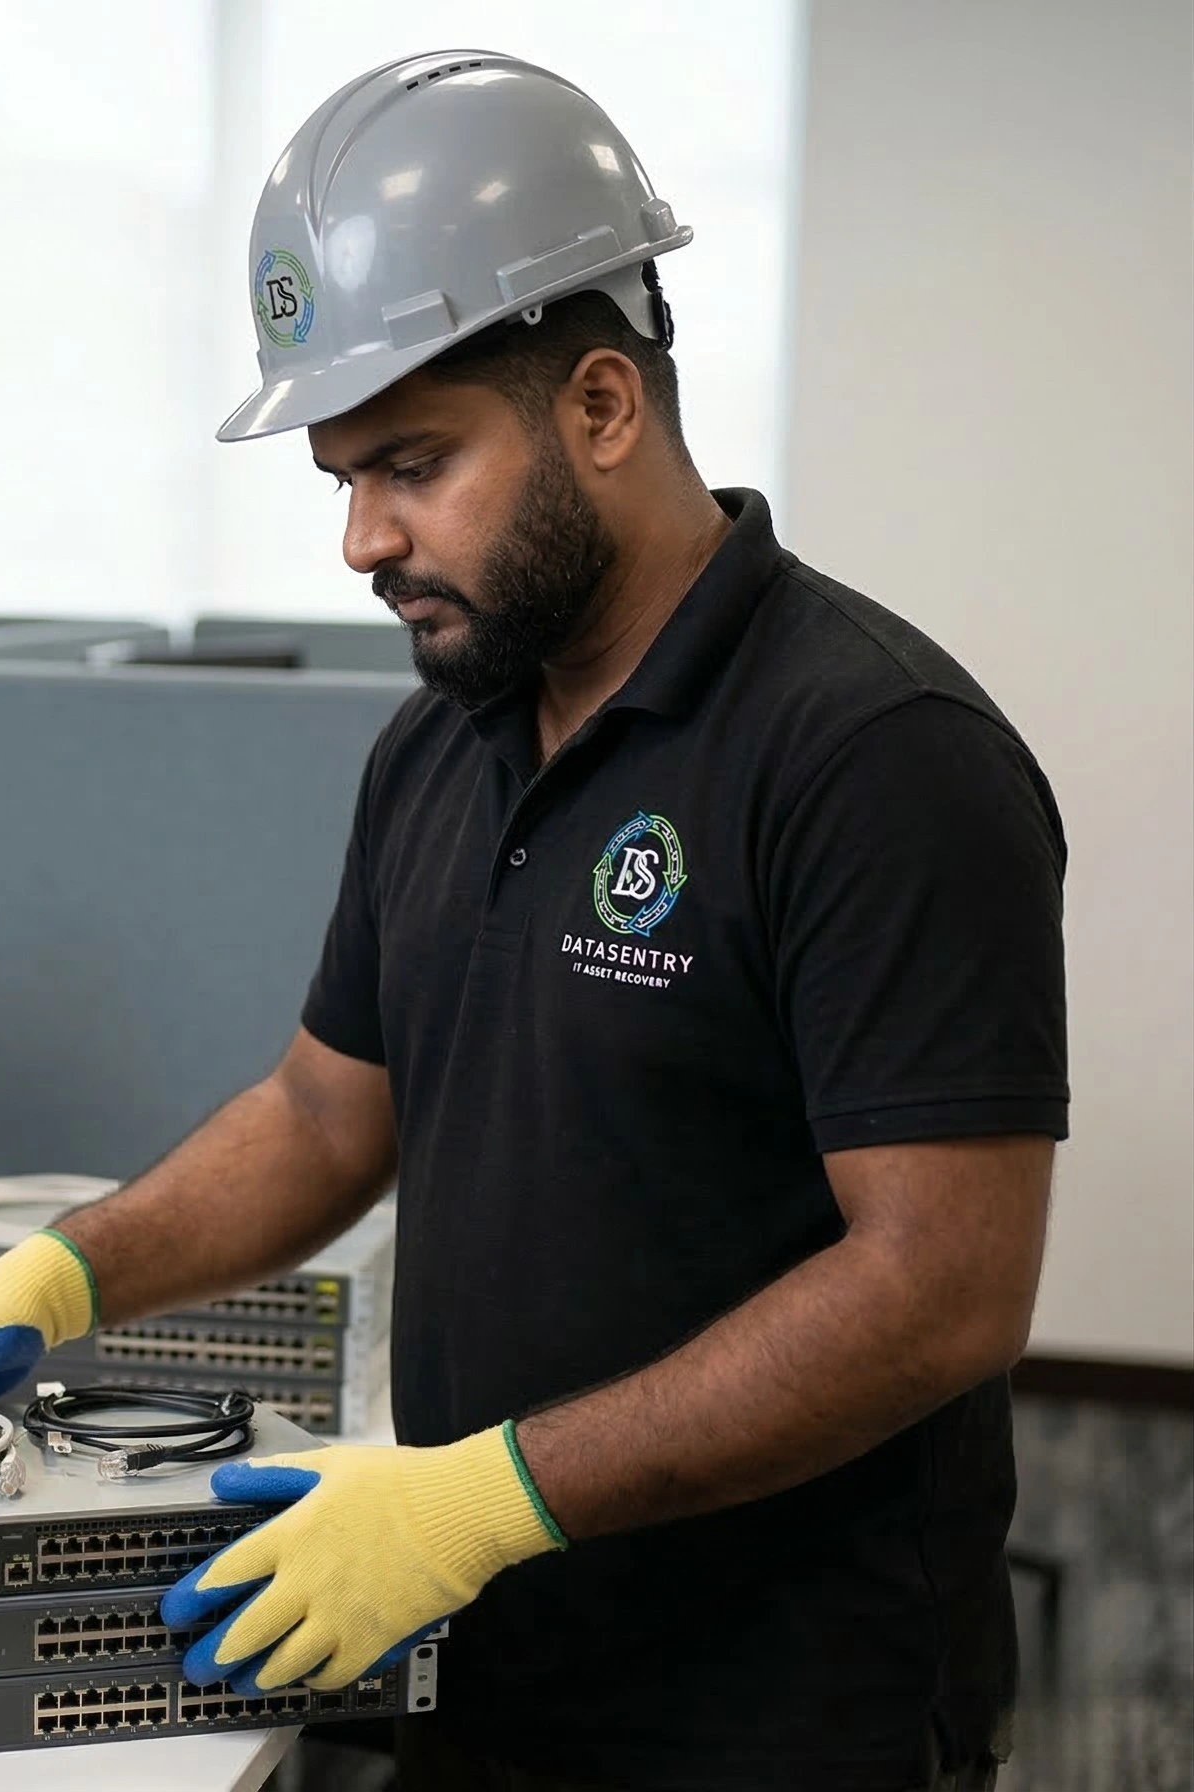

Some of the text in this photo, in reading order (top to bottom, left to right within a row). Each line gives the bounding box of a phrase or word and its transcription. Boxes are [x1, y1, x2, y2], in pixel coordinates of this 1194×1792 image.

[561, 934, 694, 973] DATASENTRY
[572, 962, 671, 988] IT ASSET RECOVERY
